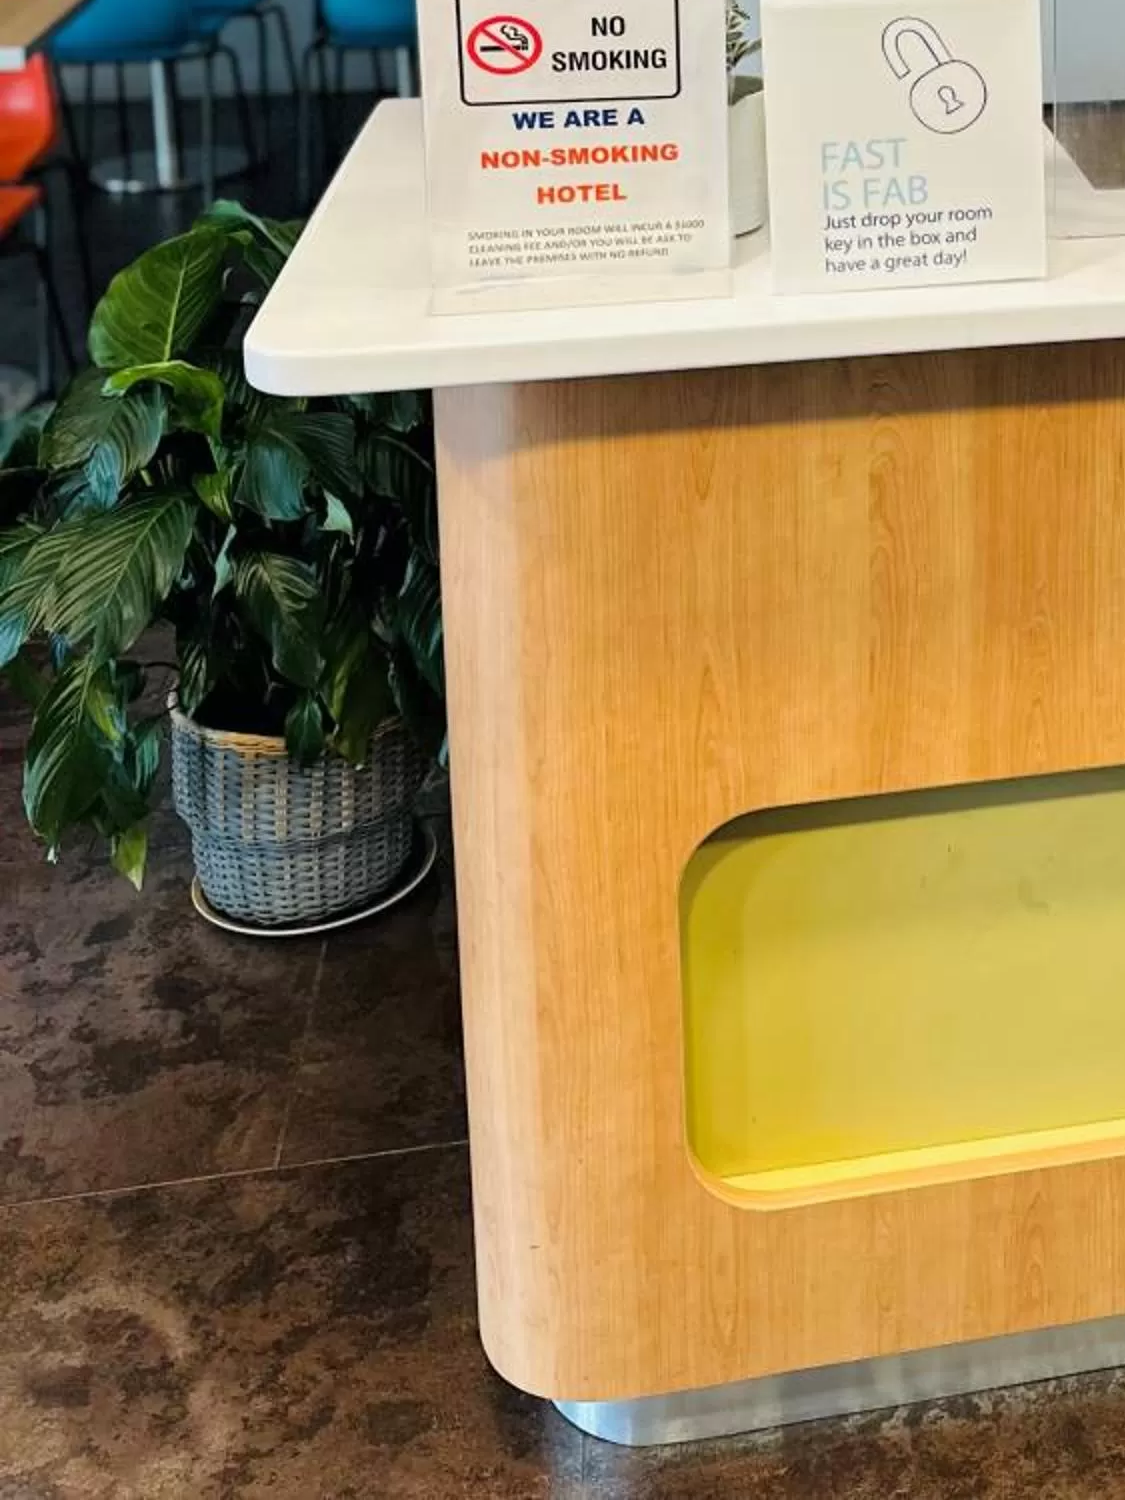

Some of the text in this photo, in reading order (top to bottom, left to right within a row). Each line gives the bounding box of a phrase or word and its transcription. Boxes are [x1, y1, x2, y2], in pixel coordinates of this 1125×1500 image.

[591, 15, 625, 37] NO
[551, 49, 667, 72] SMOKING
[512, 107, 645, 130] WE ARE A
[480, 143, 679, 170] NON-SMOKING
[821, 137, 909, 174] FAST
[537, 183, 628, 205] HOTEL
[823, 174, 929, 211] IS FAB
[824, 206, 992, 230] Just drop your room
[468, 231, 519, 241] SMOKING
[521, 229, 533, 238] IN
[536, 227, 566, 237] YOUR
[568, 225, 601, 235] ROOM
[665, 221, 673, 230] A
[825, 227, 977, 254] key in the box and
[469, 242, 522, 253] CLEANING
[590, 237, 613, 247] YOU
[469, 257, 501, 267] LEAVE
[504, 255, 523, 265] THE
[579, 251, 607, 261] WITH
[609, 249, 625, 259] NO
[825, 248, 968, 273] have a great day!
